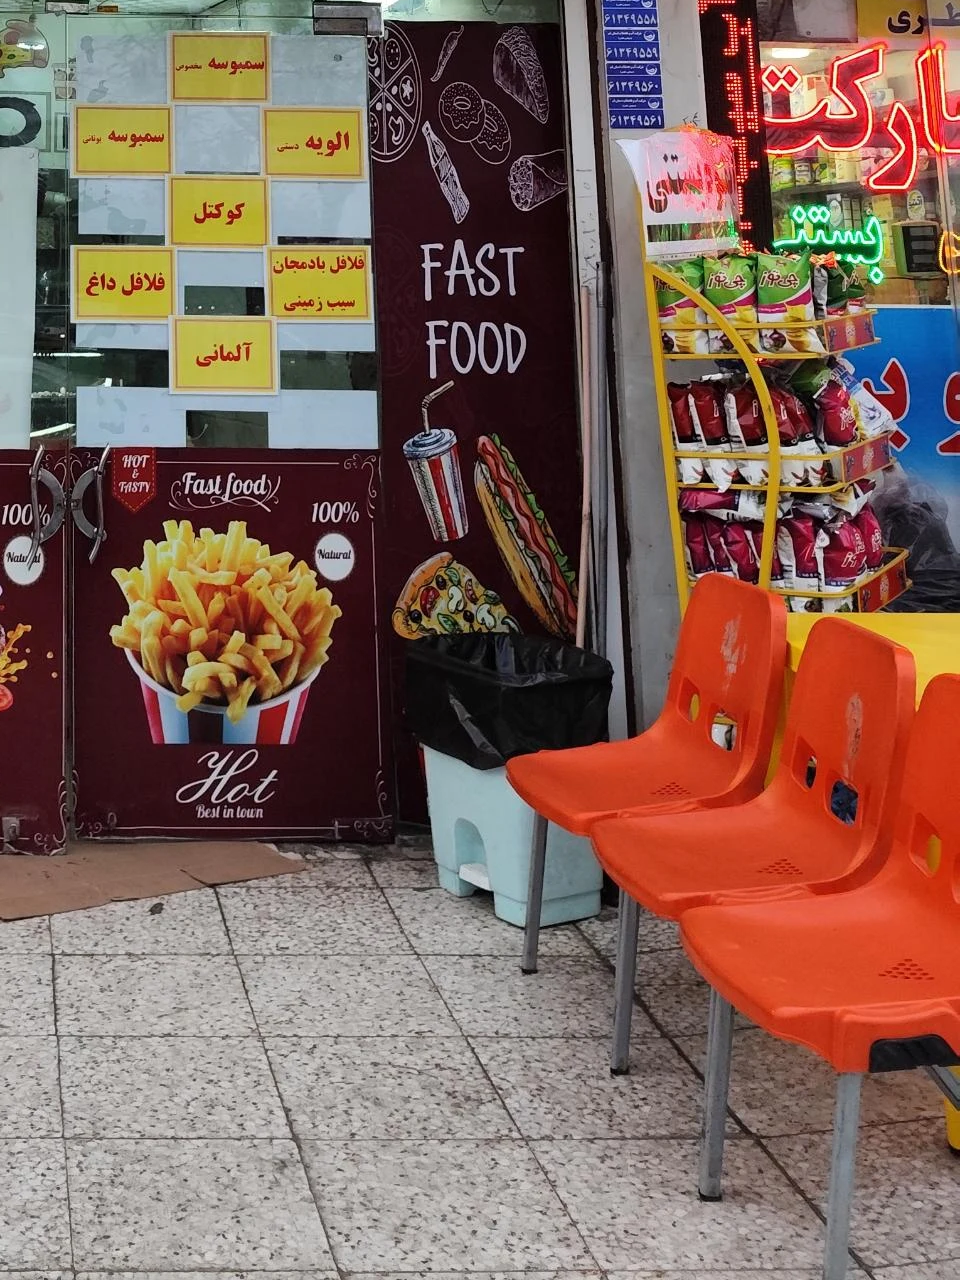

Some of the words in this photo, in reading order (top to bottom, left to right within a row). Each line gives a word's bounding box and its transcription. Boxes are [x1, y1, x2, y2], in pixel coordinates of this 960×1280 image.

[604, 13, 657, 25] ۶۱۳۴۹۵۵۸
[606, 47, 658, 58] ۶۱۳۴۹۵۵۹
[208, 57, 265, 75] سمبوسه
[608, 80, 659, 92] ۶۱۳۴۹۵۶۰
[610, 114, 662, 127] ۶۱۳۴۹۵۶۱
[108, 130, 165, 148] سمبوسه
[305, 130, 350, 157] الویه
[193, 201, 246, 226] کوکتل
[272, 255, 326, 274] بادمجان
[329, 255, 365, 274] فلافل
[420, 238, 525, 302] FAST
[85, 271, 117, 297] داغ
[121, 271, 166, 297] فلافل
[283, 295, 323, 312] زمینی
[326, 297, 356, 312] سیب
[196, 342, 253, 368] آلمانی
[425, 320, 527, 380] FOOD
[122, 454, 151, 468] HOT
[131, 468, 140, 479] &
[118, 481, 152, 494] TASTY
[181, 471, 224, 496] Fast
[220, 472, 268, 501] food
[311, 500, 360, 524] 100%
[6, 551, 42, 564] Natual
[316, 548, 352, 561] Natural
[175, 748, 279, 804] Hot
[196, 803, 220, 819] Best
[223, 805, 234, 819] in
[236, 805, 264, 819] town
